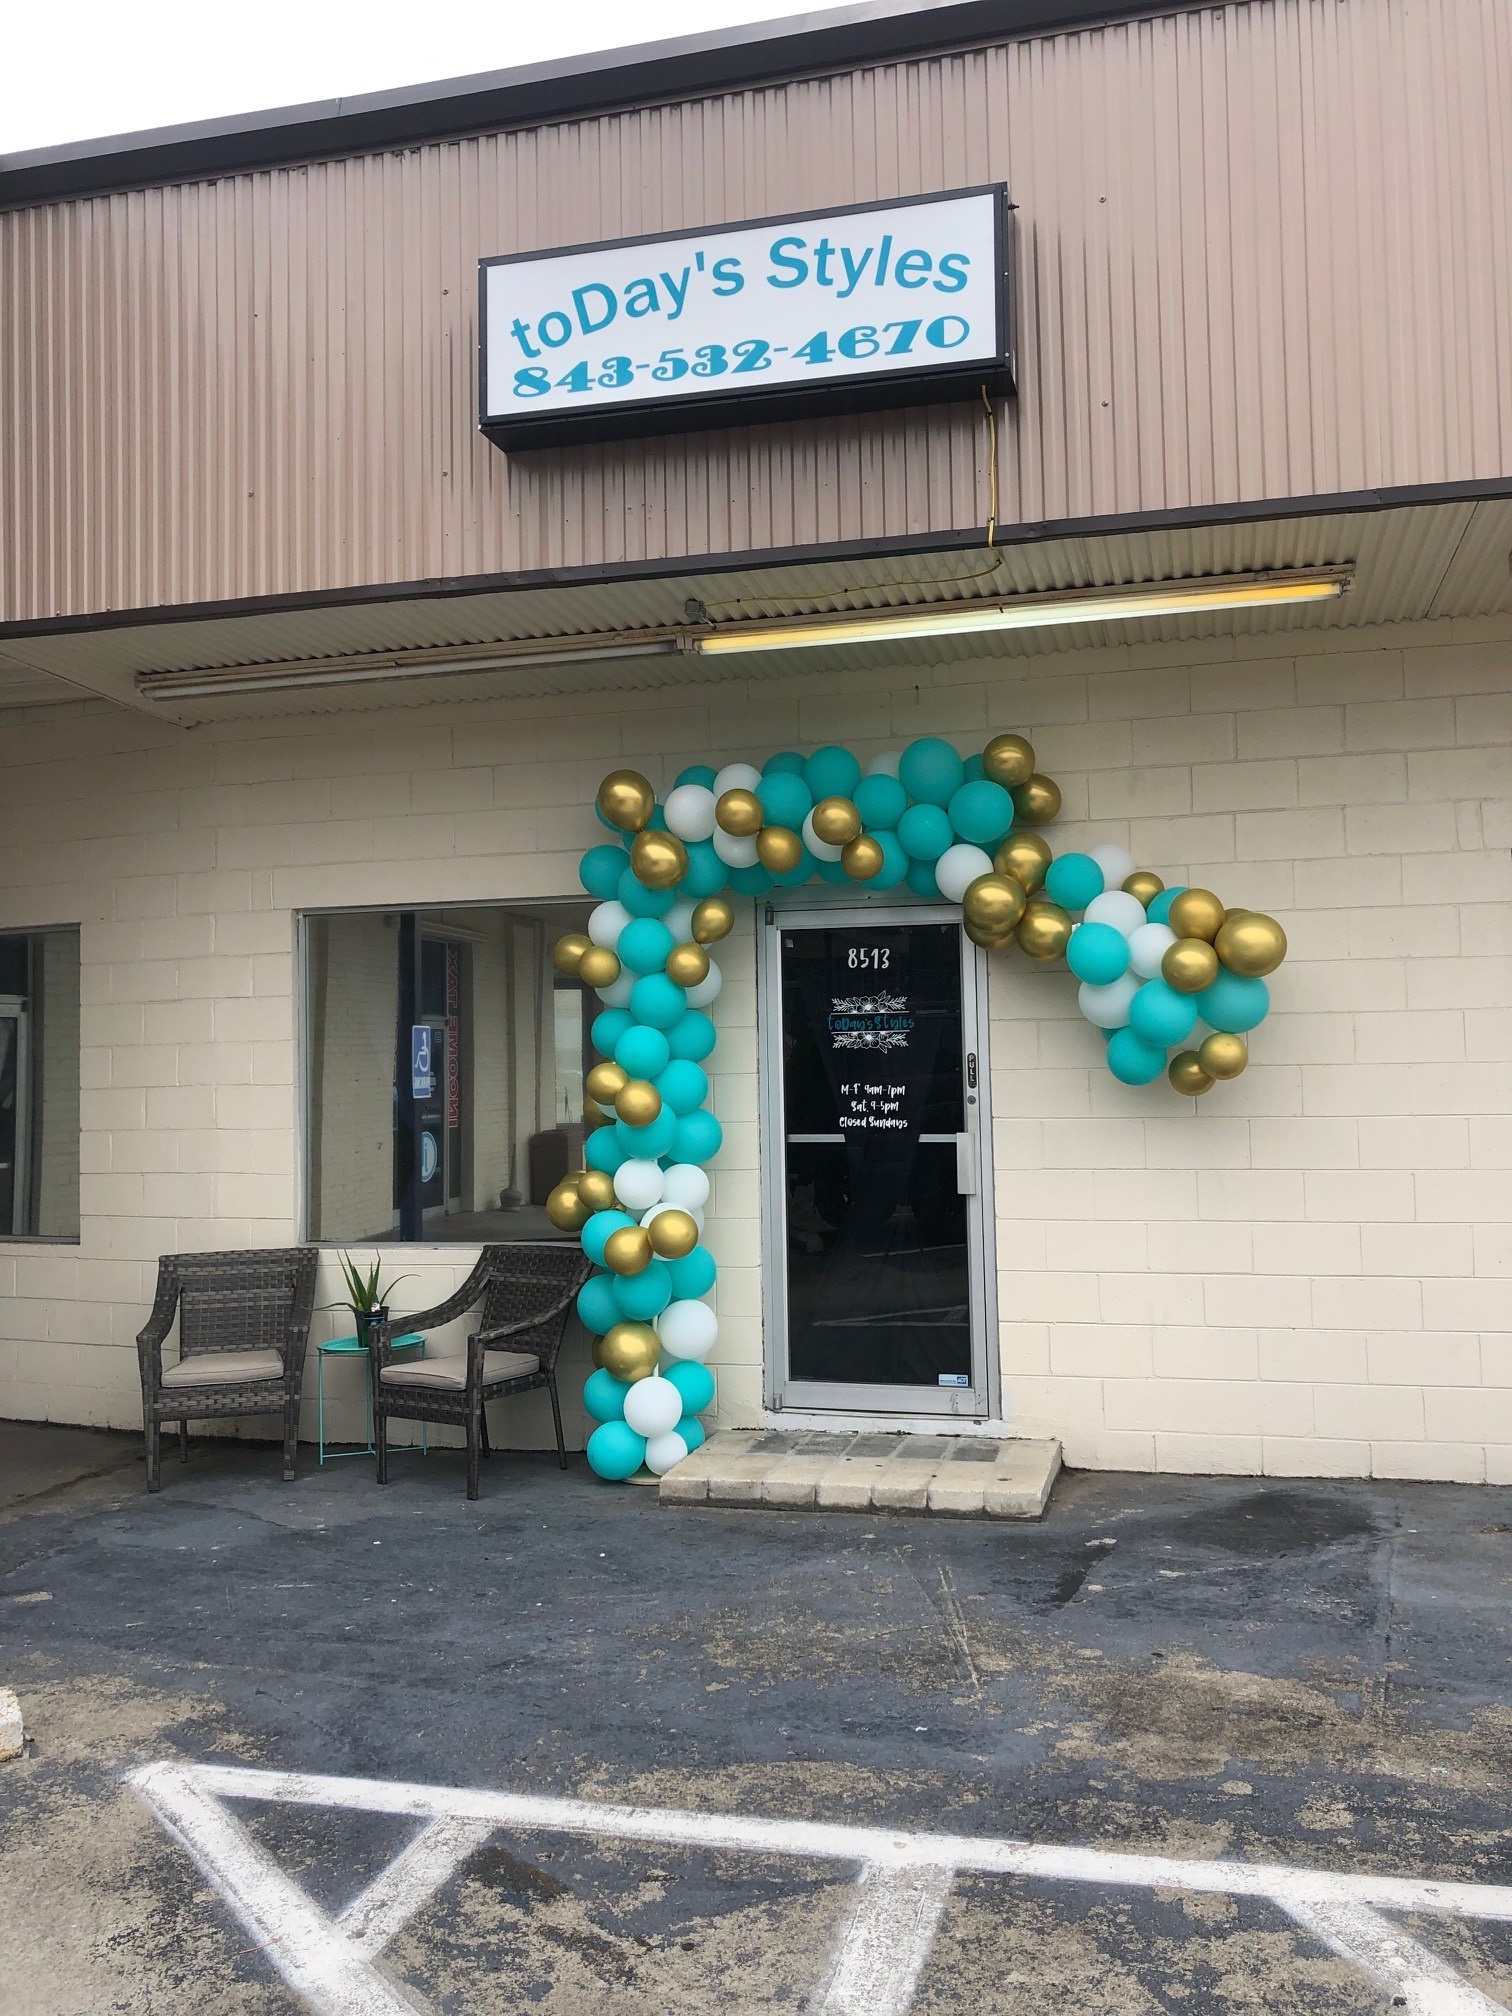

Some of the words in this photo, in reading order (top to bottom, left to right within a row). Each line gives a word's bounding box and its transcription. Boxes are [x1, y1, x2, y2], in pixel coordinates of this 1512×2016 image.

[510, 251, 745, 358] toDay's
[766, 235, 971, 298] Styles
[512, 315, 970, 398] 843-532-4670
[848, 948, 890, 969] 8513
[874, 1013, 915, 1031] Styles
[841, 1083, 861, 1096] M-F
[851, 1099, 869, 1113] Sat.
[870, 1100, 899, 1114] 9-5pm
[839, 1116, 867, 1128] Closed
[868, 1115, 908, 1129] Sundays
